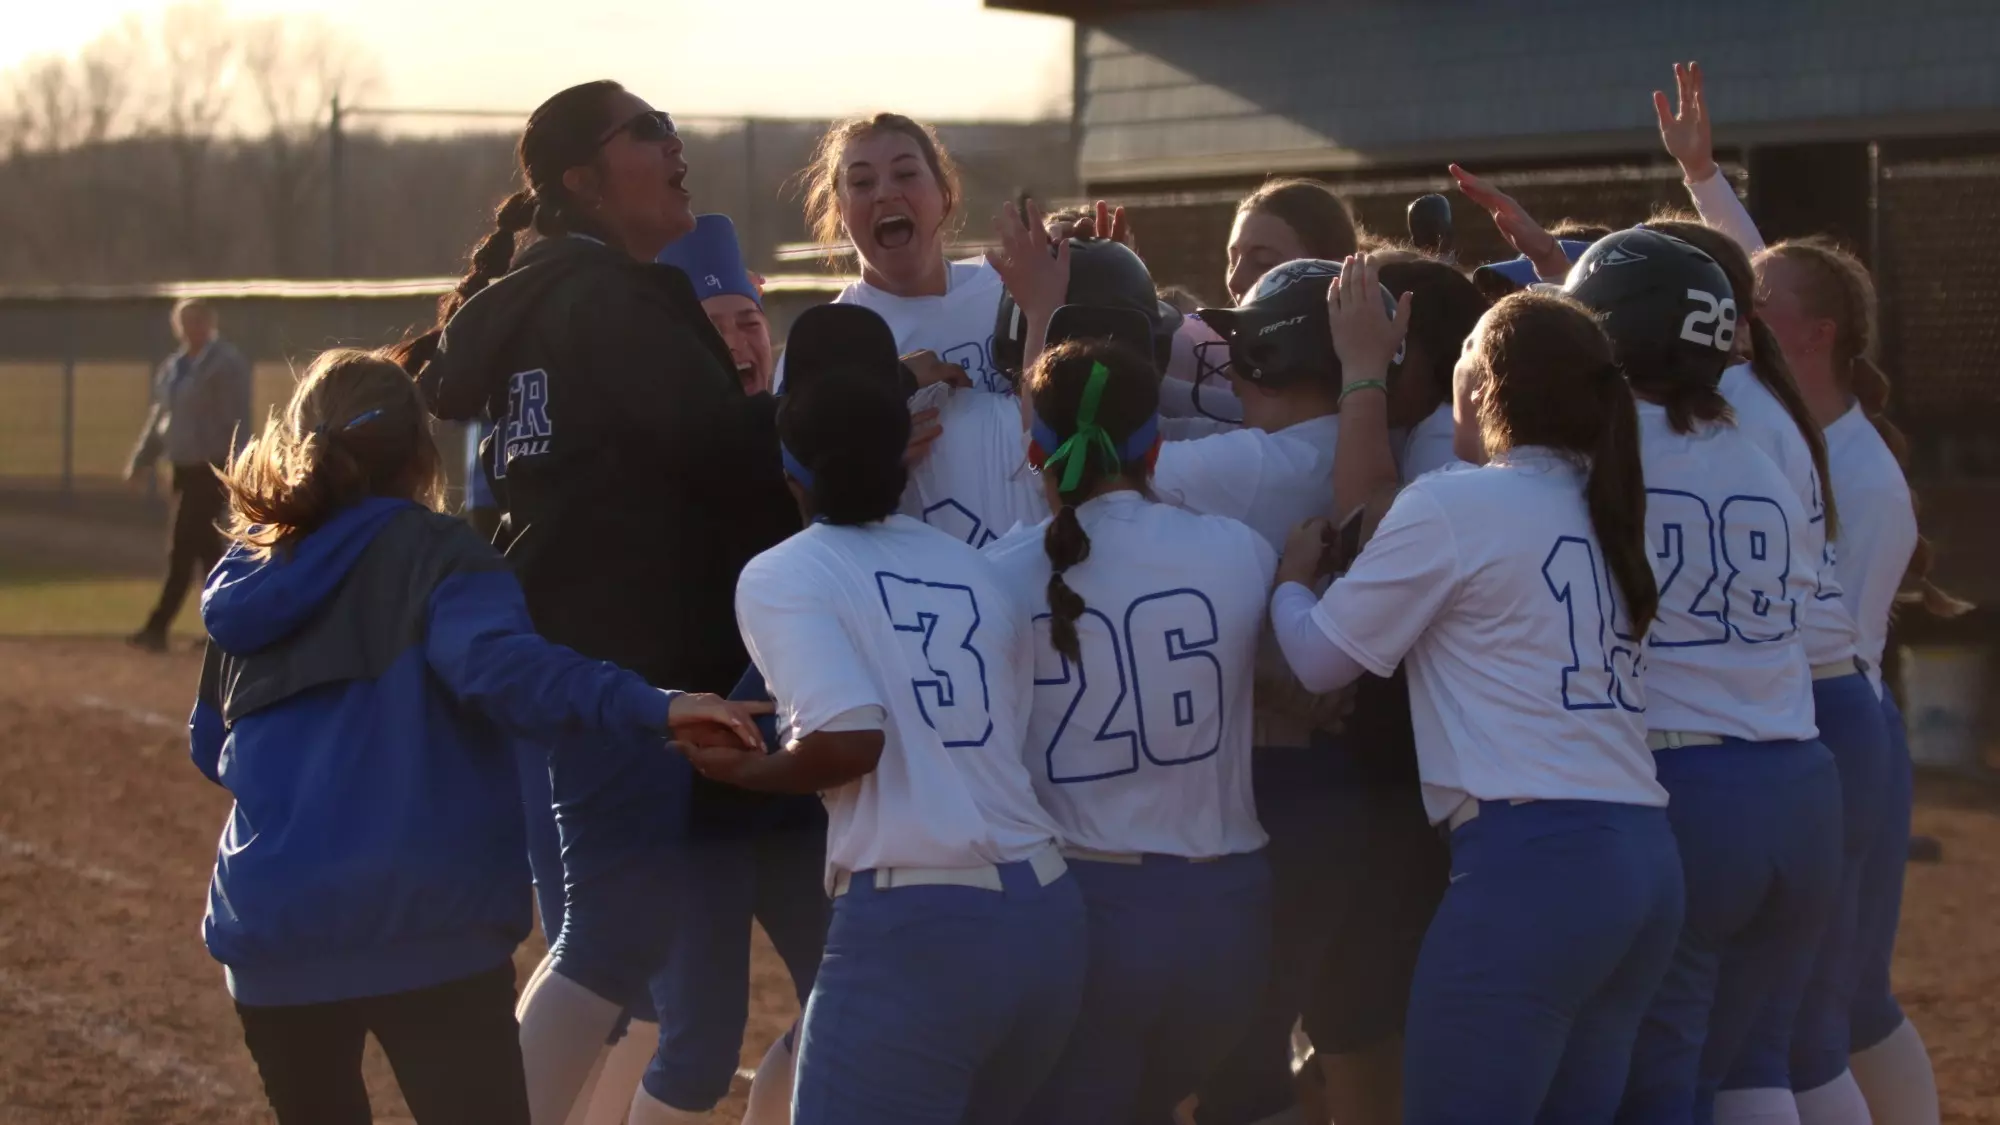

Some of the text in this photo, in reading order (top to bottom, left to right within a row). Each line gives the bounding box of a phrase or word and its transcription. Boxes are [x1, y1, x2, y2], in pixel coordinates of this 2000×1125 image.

[1259, 315, 1308, 337] RIP-IT
[1680, 288, 1737, 351] 28
[1645, 488, 1797, 648] 28
[875, 571, 994, 748] 3
[1032, 587, 1224, 784] 26
